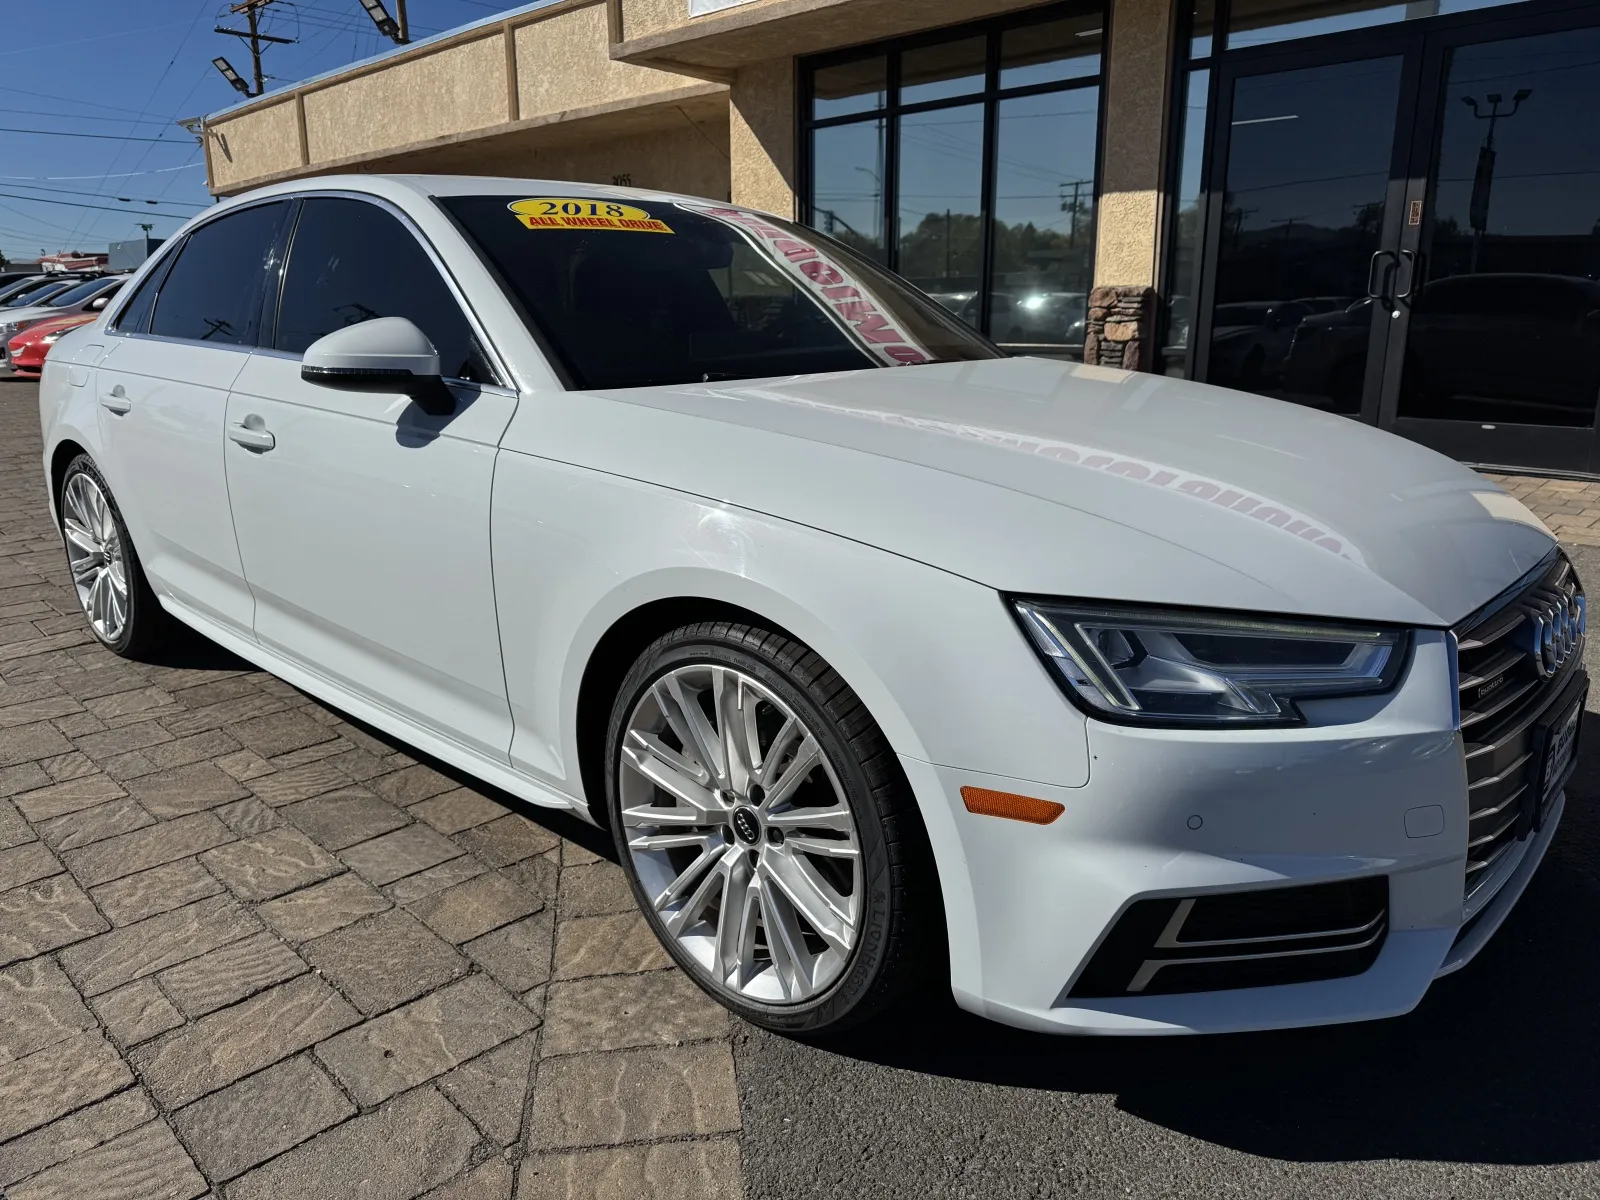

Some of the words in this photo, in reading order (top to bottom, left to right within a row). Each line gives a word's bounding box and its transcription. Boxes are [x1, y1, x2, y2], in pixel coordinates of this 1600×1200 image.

[538, 201, 625, 218] 2018
[528, 216, 560, 227] ALL
[560, 216, 618, 228] WHEEL
[617, 218, 667, 232] DRIVE
[1480, 676, 1504, 696] quattro
